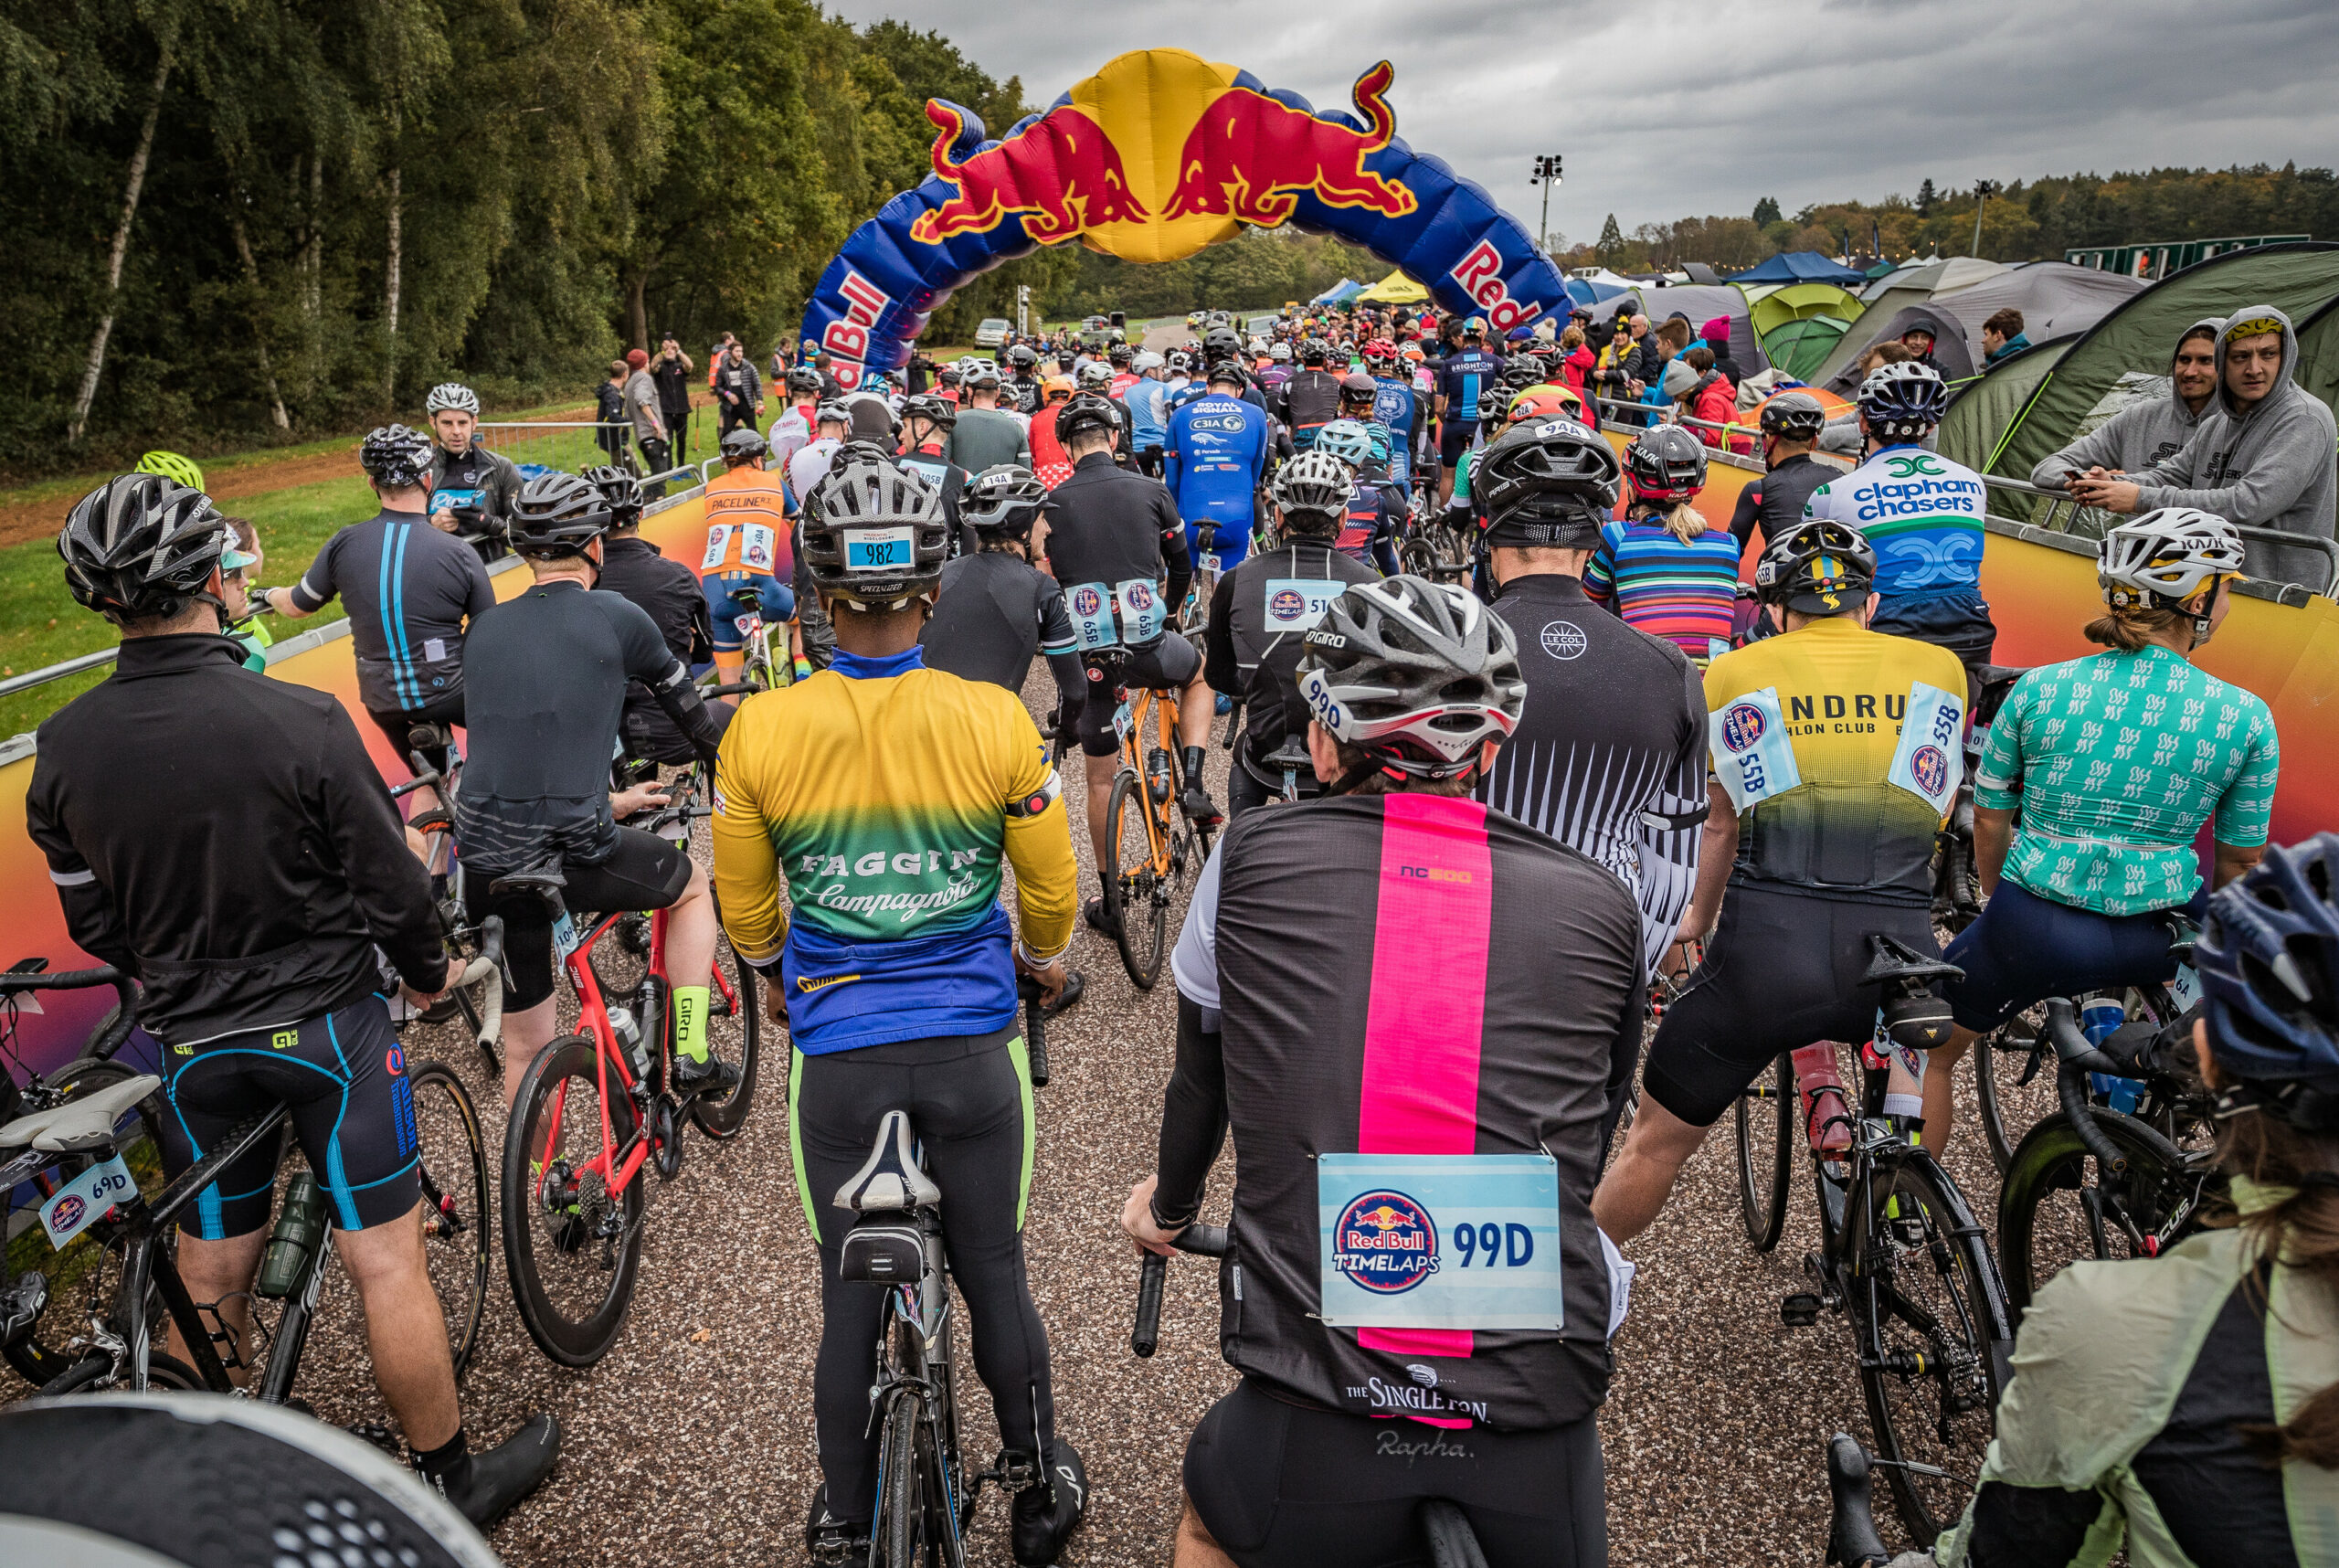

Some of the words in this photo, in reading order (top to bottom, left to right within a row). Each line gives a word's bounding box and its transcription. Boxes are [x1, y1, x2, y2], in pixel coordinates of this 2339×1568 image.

[1452, 240, 1540, 334] Red
[823, 272, 888, 361] Bull
[1452, 362, 1493, 372] BRIGHTON
[1516, 405, 1530, 418] 62A
[773, 418, 799, 431] CYMRU
[1193, 419, 1221, 429] C3IA
[1544, 422, 1582, 436] 94A
[1635, 445, 1659, 465] KASK
[920, 473, 942, 485] 105B
[989, 475, 1008, 485] 14A
[1854, 479, 1982, 503] clapham
[712, 497, 760, 511] PACELINE
[1857, 494, 1974, 521] chasers
[755, 528, 764, 545] 50A
[708, 548, 716, 564] 50A
[866, 543, 894, 565] 982
[1757, 566, 1771, 585] 55B
[860, 584, 902, 593] SPECIALIZED
[1269, 608, 1306, 616] TIMELAPS
[1311, 599, 1327, 613] 51
[1084, 620, 1099, 643] 65B
[1139, 615, 1151, 637] 65B
[1314, 632, 1347, 649] GIRO
[1309, 679, 1340, 729] 99D
[1780, 694, 1907, 721] NDRU
[1734, 710, 1746, 727] Red
[1835, 723, 1876, 735] CLUB
[1933, 705, 1961, 747] 55B
[1739, 727, 1753, 747] Bull
[1969, 734, 1985, 747] 101
[1928, 752, 1939, 771] Bull
[1738, 752, 1766, 793] 55B
[1925, 770, 1934, 788] Red
[800, 847, 981, 877] FAGGIN
[1401, 865, 1473, 884] nc500
[804, 871, 981, 923] Campagnolo
[568, 965, 584, 989] BMC
[2175, 977, 2190, 999] 6A
[678, 997, 693, 1042] GIRO
[391, 1078, 407, 1158] Transmission
[399, 1075, 418, 1152] Allison
[92, 1174, 126, 1200] 69D
[53, 1204, 89, 1235] TIMELAPS
[54, 1210, 66, 1225] Red
[64, 1201, 80, 1218] Bull
[2157, 1197, 2192, 1245] CUS
[1348, 1231, 1386, 1250] Red
[1387, 1231, 1424, 1251] Bull
[1454, 1222, 1534, 1268] 99D
[1332, 1253, 1441, 1274] TIMELAPS
[1346, 1386, 1369, 1398] THE
[1368, 1376, 1488, 1423] SINGLETON
[1376, 1428, 1476, 1468] Rapha.
